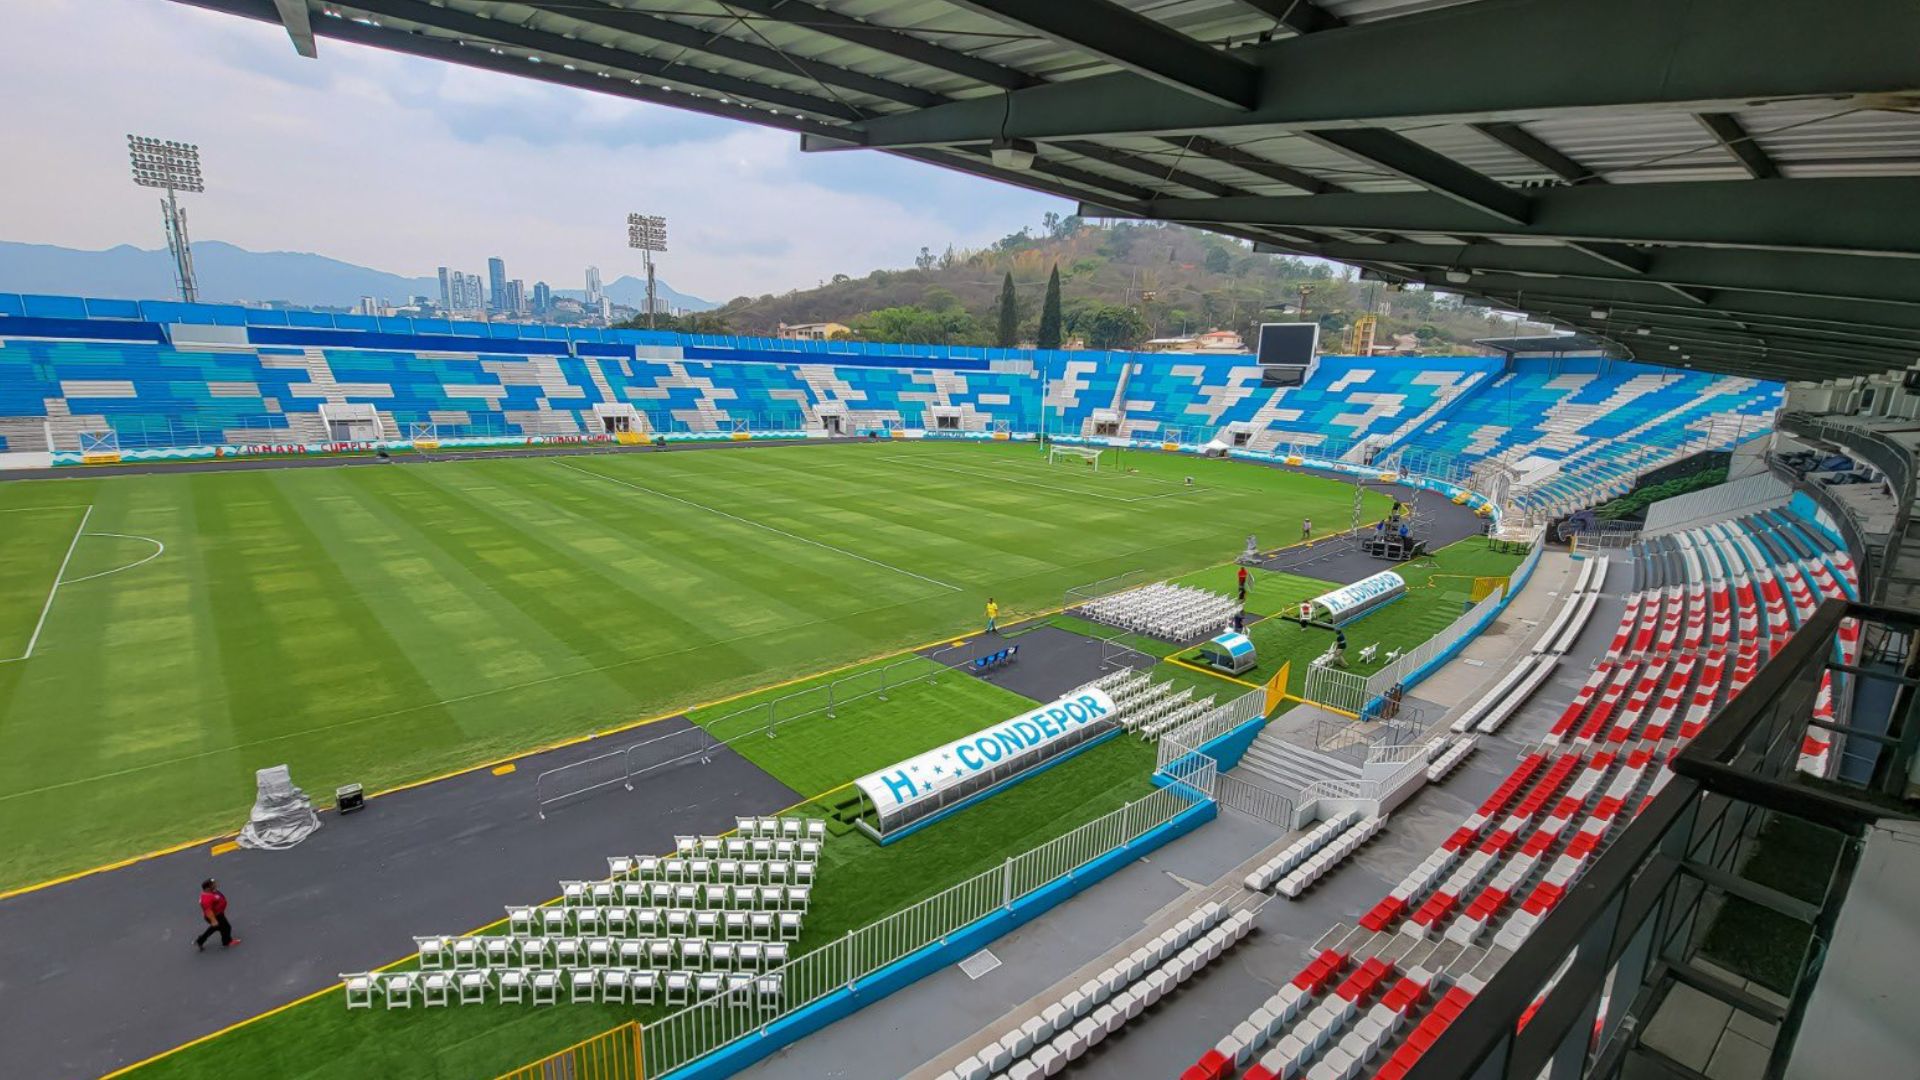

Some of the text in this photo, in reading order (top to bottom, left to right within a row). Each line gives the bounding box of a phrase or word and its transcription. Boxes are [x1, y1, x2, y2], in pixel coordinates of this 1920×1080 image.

[320, 441, 373, 454] CUMPLE
[1347, 573, 1401, 602] CONDEPOR
[880, 694, 1108, 804] H CONDEPOR
